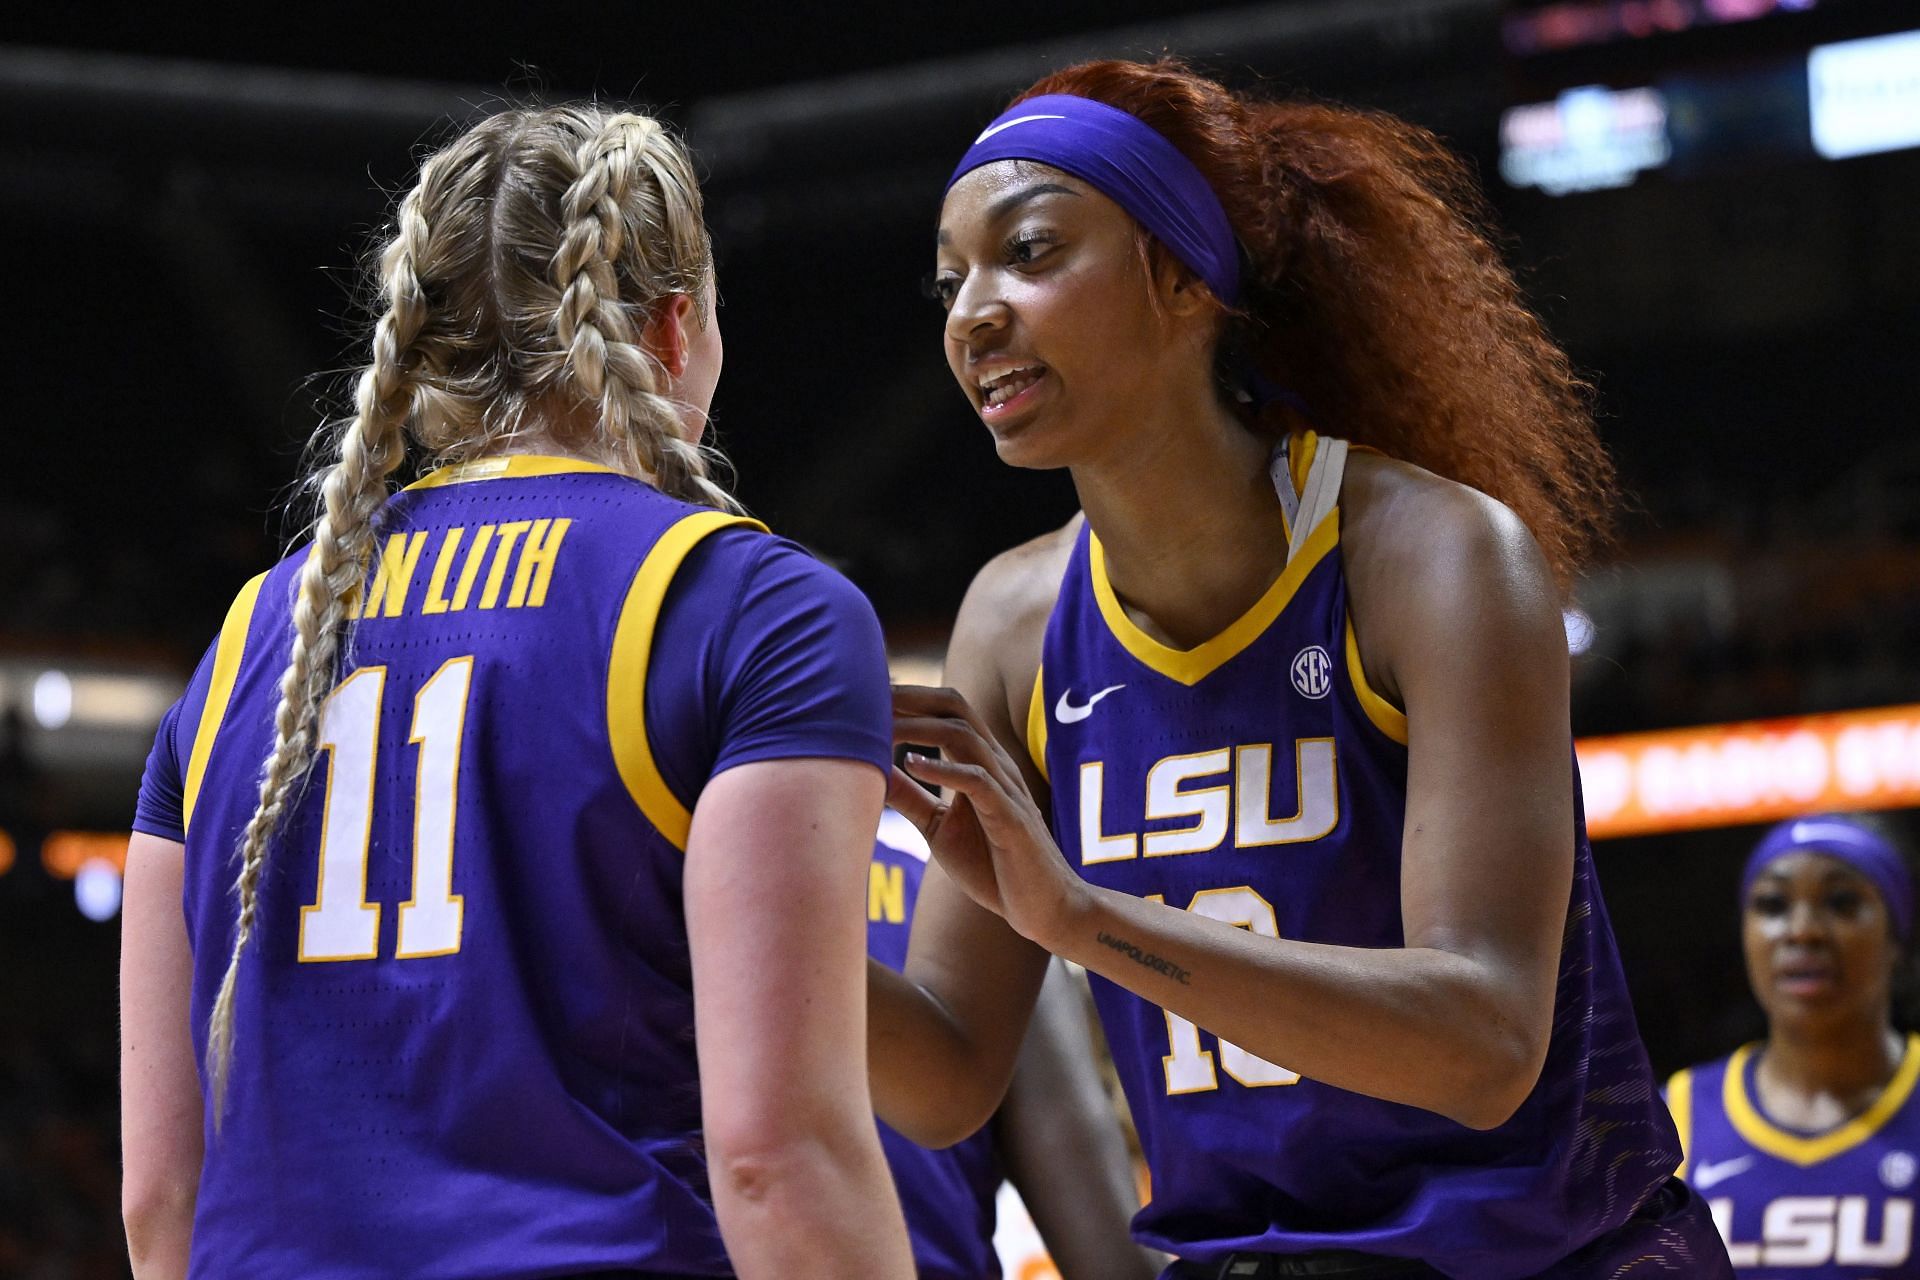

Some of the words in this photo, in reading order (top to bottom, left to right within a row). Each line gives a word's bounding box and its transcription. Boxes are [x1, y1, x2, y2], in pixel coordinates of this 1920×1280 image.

[421, 518, 572, 615] LITH
[1295, 651, 1329, 695] SEC
[298, 655, 475, 963] 11
[1079, 737, 1339, 866] LSU
[1700, 1196, 1914, 1268] LSU
